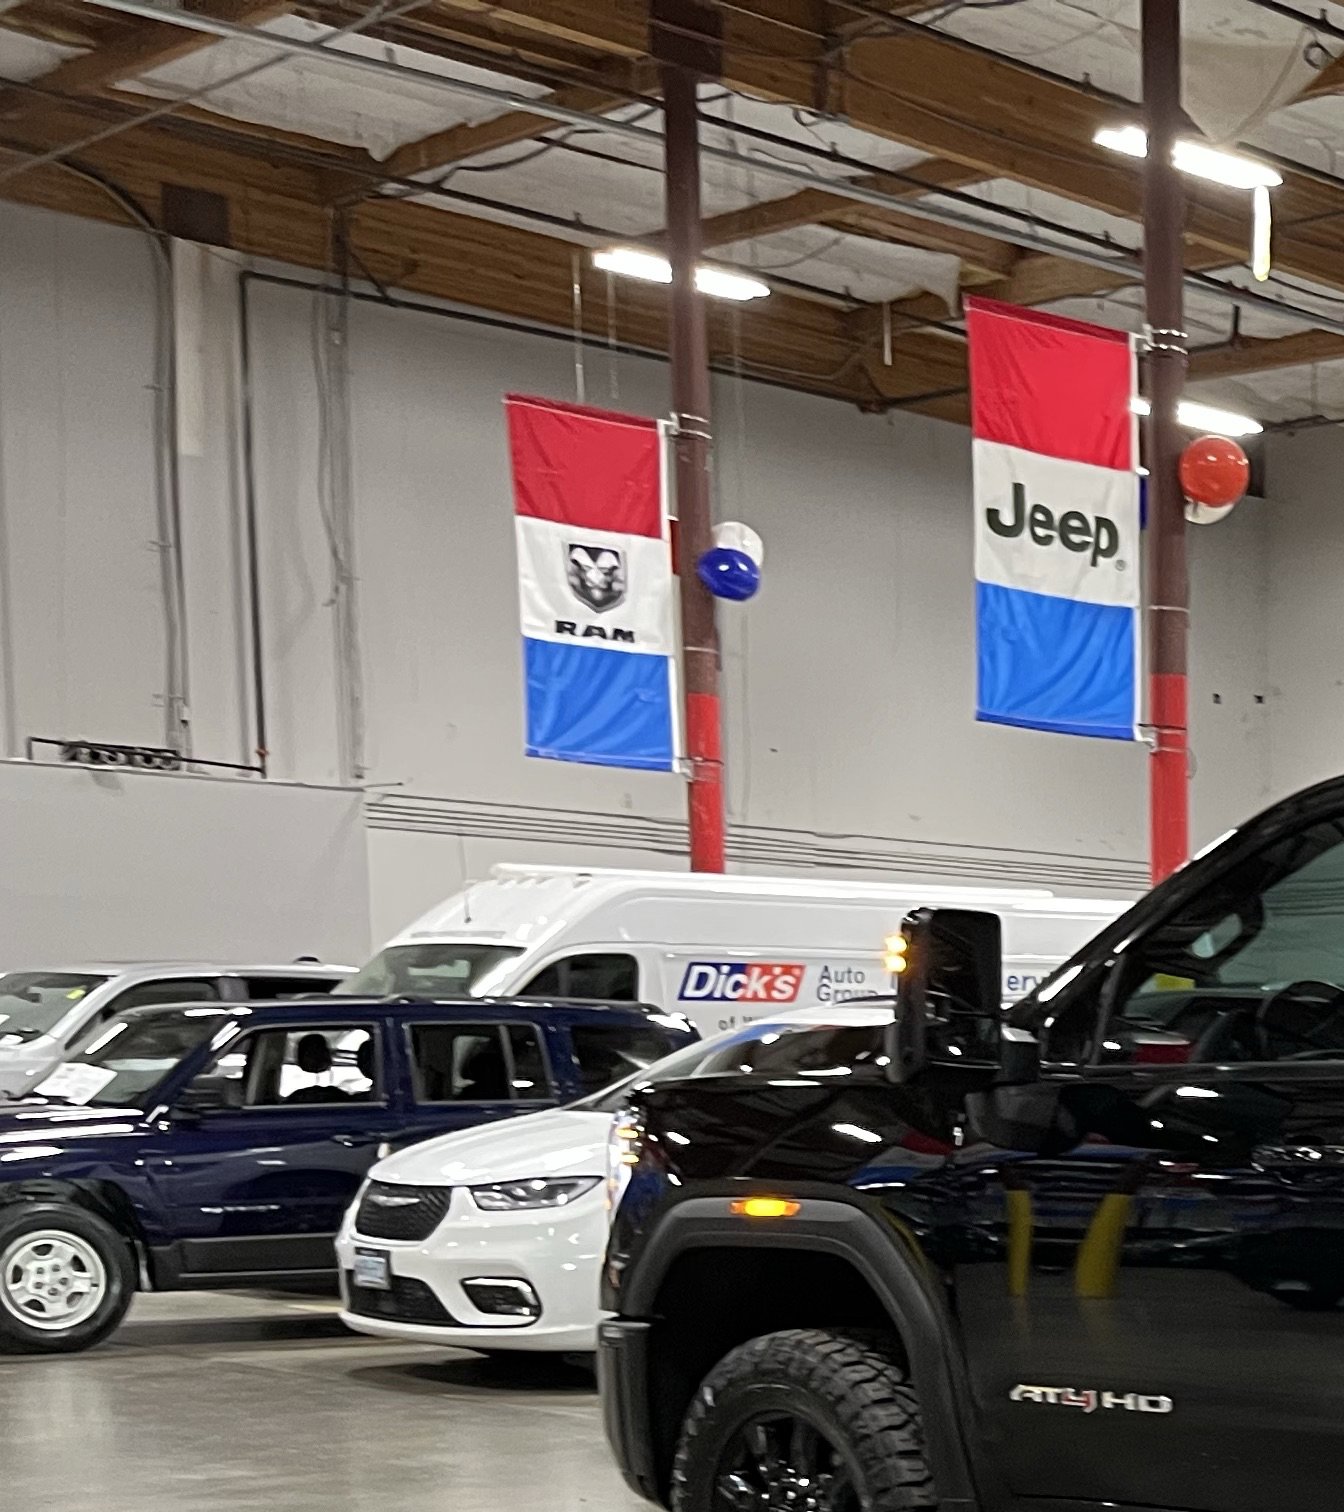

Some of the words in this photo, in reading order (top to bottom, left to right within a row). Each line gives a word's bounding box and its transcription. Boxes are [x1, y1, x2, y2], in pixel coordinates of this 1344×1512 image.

[986, 481, 1119, 568] Jeep
[555, 619, 635, 643] RAM
[682, 964, 796, 1000] Dick's
[819, 965, 866, 984] Auto
